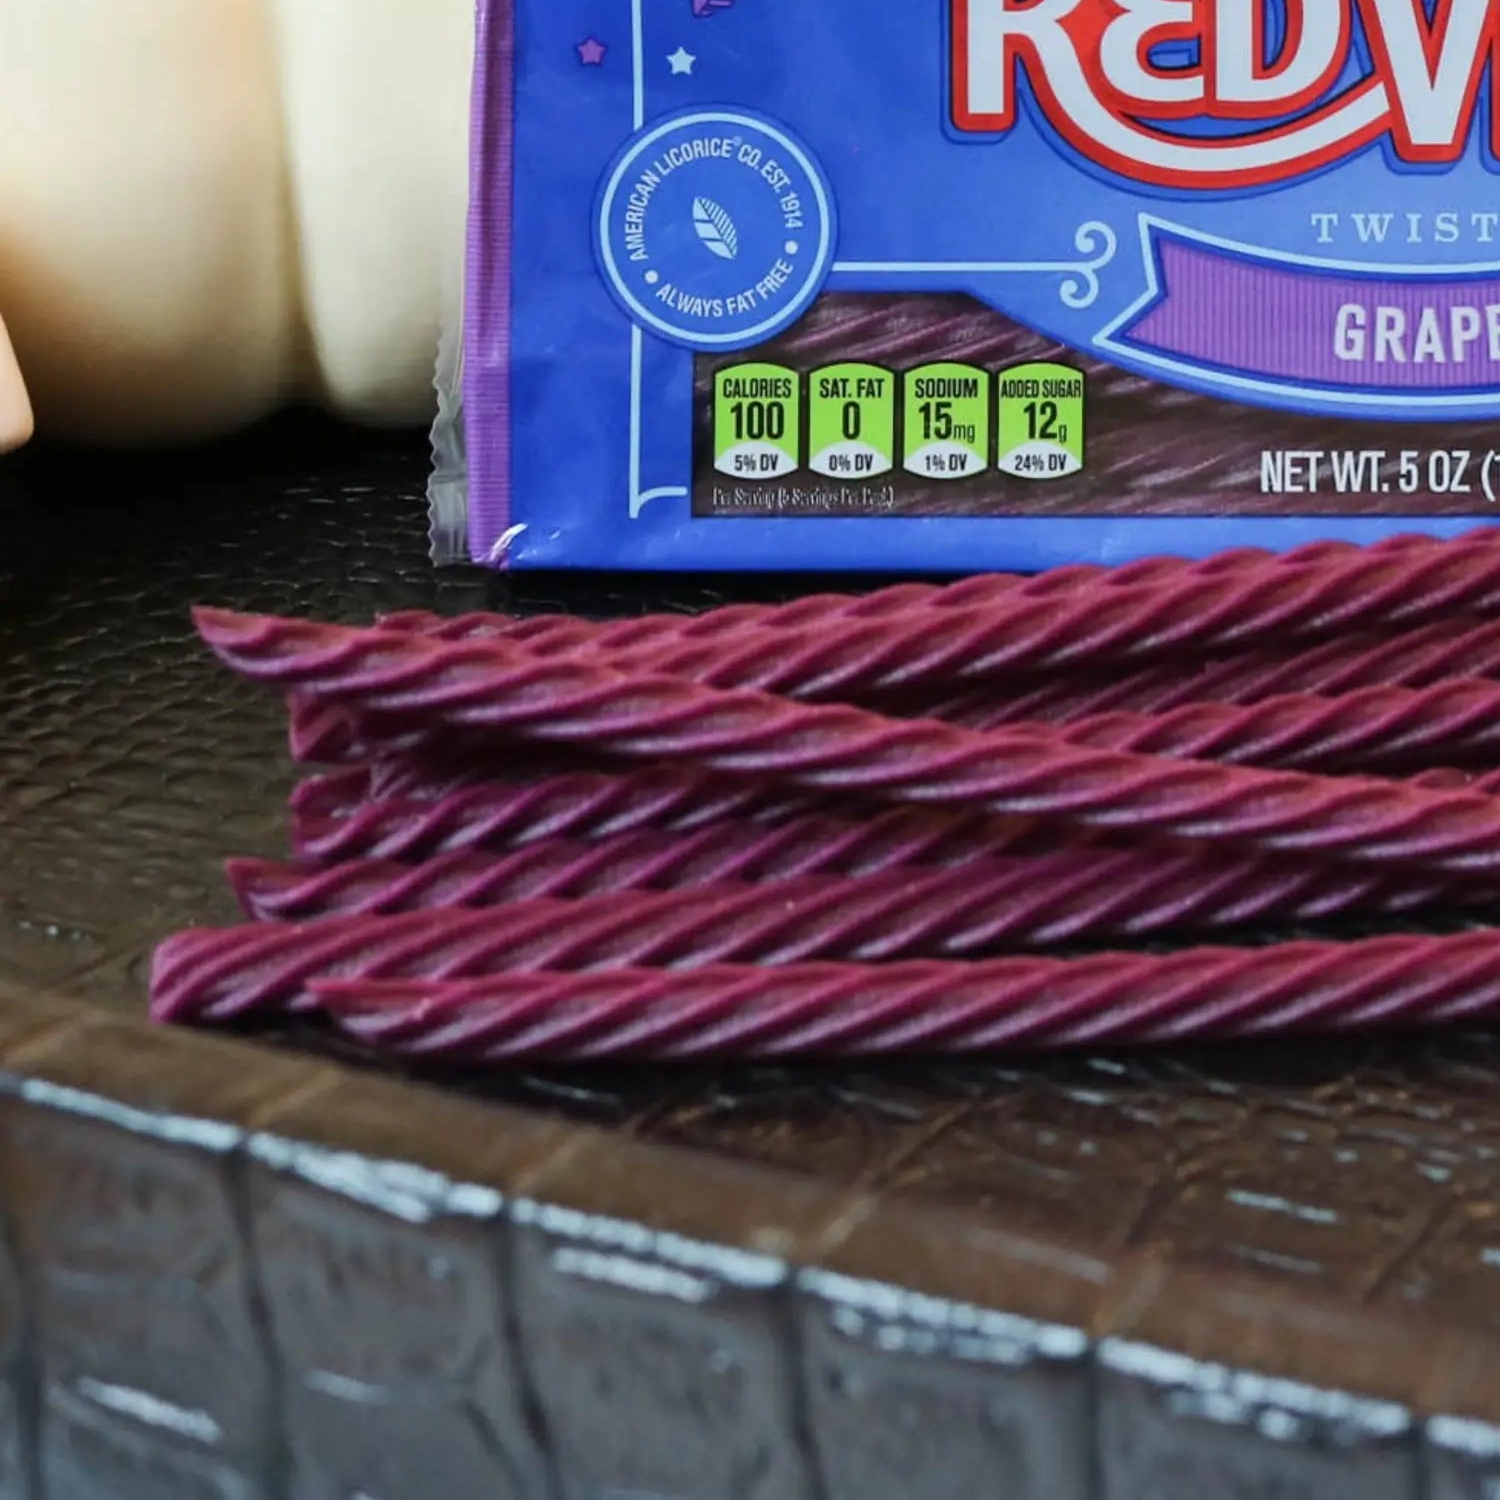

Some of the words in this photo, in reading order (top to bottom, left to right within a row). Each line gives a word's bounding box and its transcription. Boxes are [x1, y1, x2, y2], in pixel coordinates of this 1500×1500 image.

[623, 168, 661, 262] AMERICAN
[738, 145, 761, 171] CO.
[759, 161, 792, 193] EST.
[780, 193, 803, 229] 1914
[656, 283, 724, 318] ALWAYS
[727, 288, 756, 316] FAT
[756, 258, 795, 300] FREE
[723, 377, 792, 399] CALORIES
[819, 377, 852, 399] SAT.
[856, 377, 885, 399] FAT
[915, 377, 979, 399] SODIUM
[1000, 378, 1040, 398] ADDED
[1042, 378, 1082, 398] SUGAR
[730, 401, 784, 440] 100
[842, 401, 861, 440] 0
[734, 453, 756, 472] 5%
[760, 453, 779, 472] DV
[829, 453, 851, 472] 0%
[854, 453, 873, 472] DV
[925, 453, 946, 472] 1%
[949, 453, 968, 472] DV
[1014, 453, 1046, 472] 24%
[1048, 453, 1067, 472] DV
[1260, 450, 1323, 494] NET
[1332, 450, 1390, 494] WT.
[1399, 450, 1420, 494] 5
[1428, 450, 1471, 494] OZ
